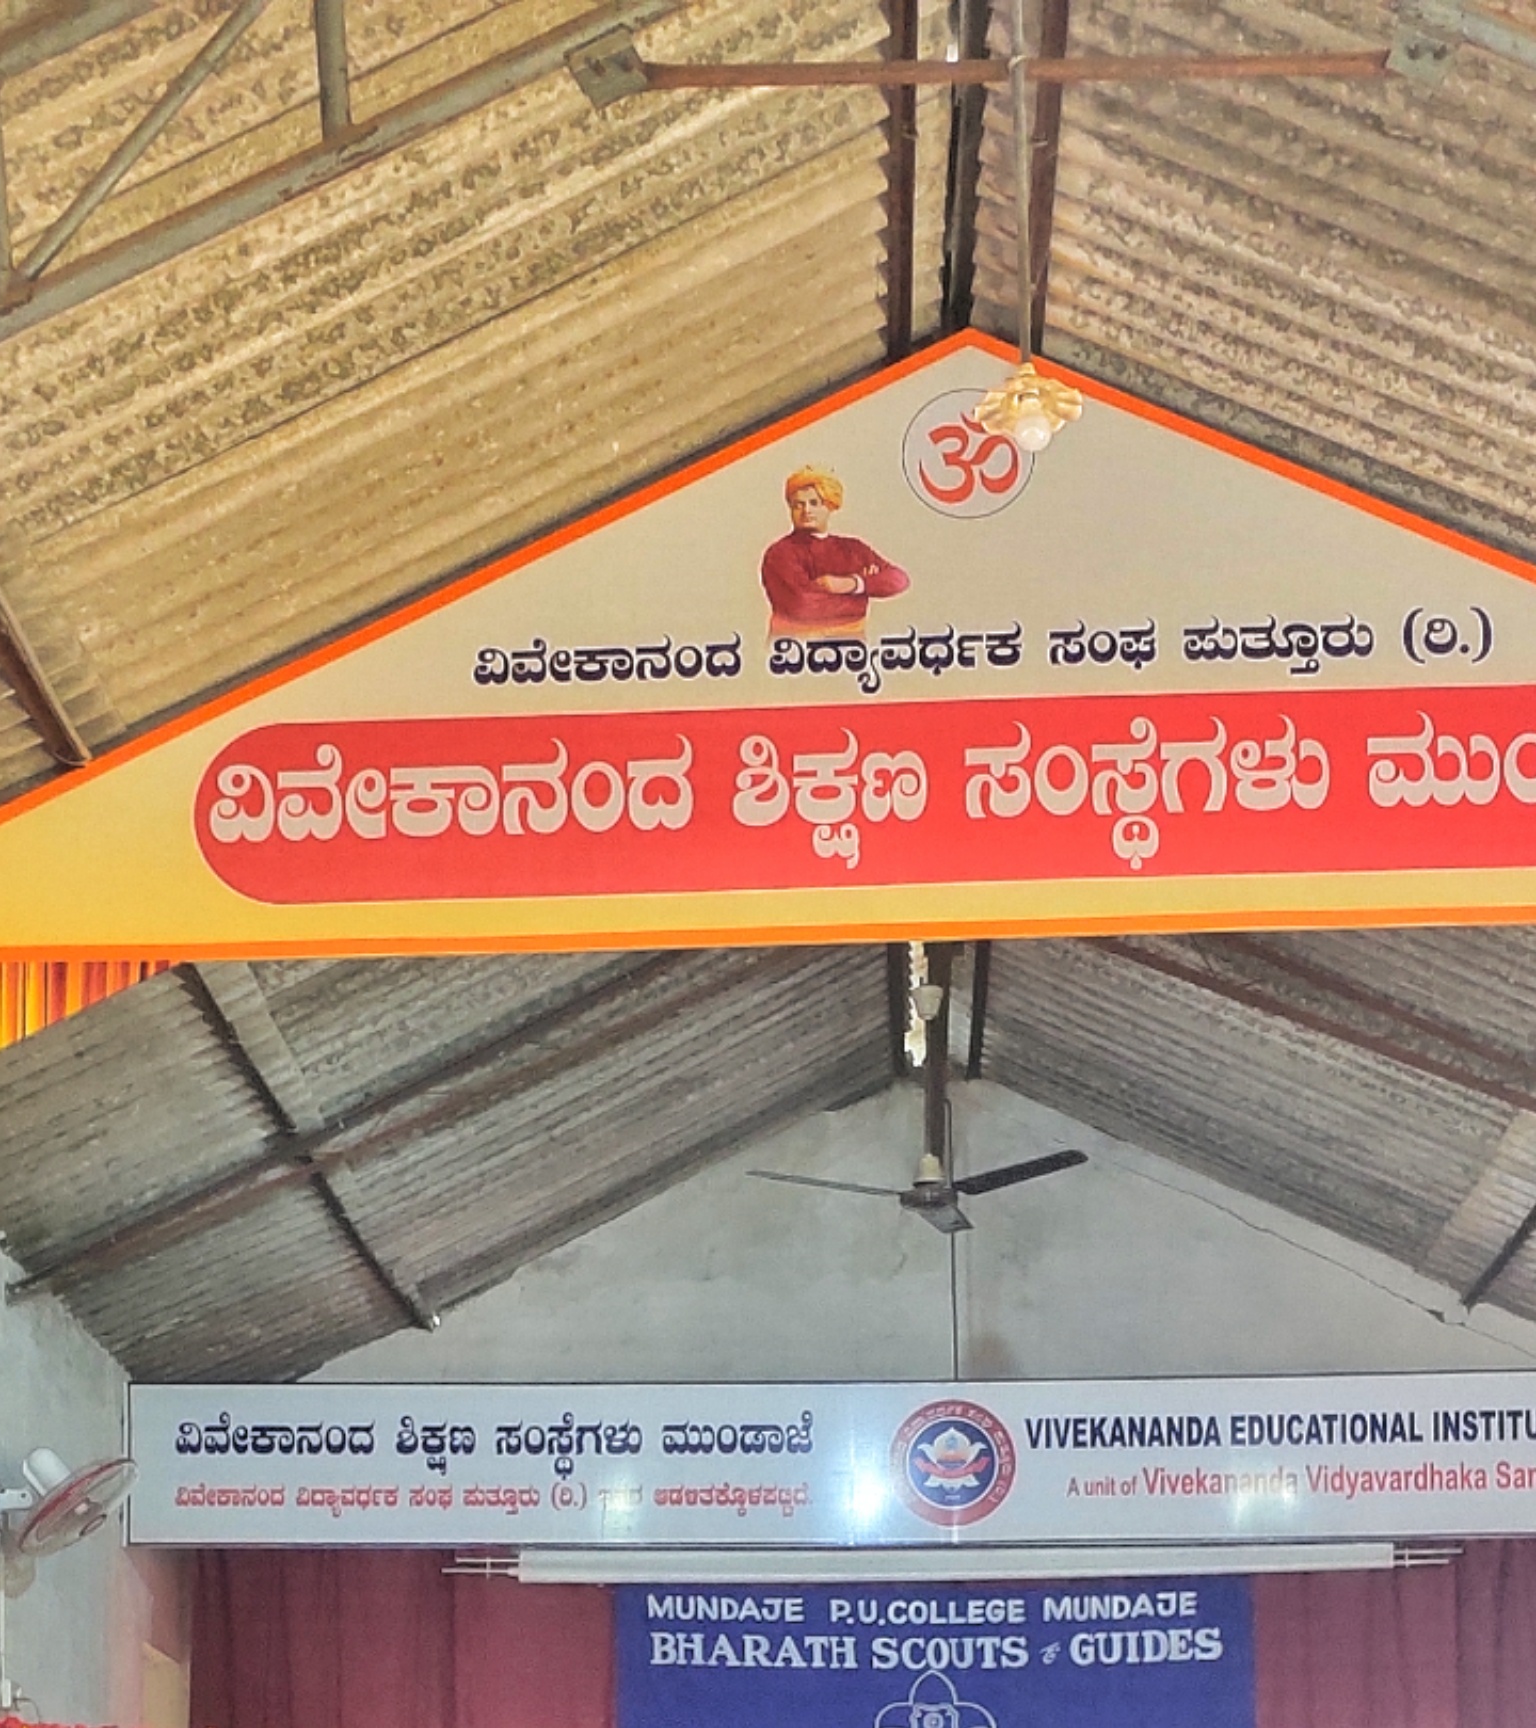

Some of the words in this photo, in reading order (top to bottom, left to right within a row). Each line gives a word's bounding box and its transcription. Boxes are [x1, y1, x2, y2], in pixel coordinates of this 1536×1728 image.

[474, 634, 741, 684] ವಿವೇಕಾನಂದ
[770, 621, 1023, 693] ವಿದ್ಯಾವರ್ಧಕ
[1050, 620, 1155, 669] ಸಂಘ
[1184, 615, 1373, 674] ಪುತ್ತೂರು
[209, 733, 694, 843] ವಿವೇಕಾನಂದ
[733, 730, 927, 869] ಶಿಕ್ಷಣ
[965, 715, 1331, 871] ಸಂಸ್ಥೆಗಳು
[176, 1412, 374, 1454] ವಿವೇಕಾನಂದ
[396, 1416, 475, 1475] ಶಿಕ್ಷಣ
[496, 1412, 642, 1480] ಸಂಸ್ಥೆಗಳು
[662, 1411, 812, 1454] ಮುಂಡಾಜೆ
[1026, 1416, 1220, 1448] VIVEKANANDA
[1231, 1412, 1423, 1445] EDUCATIONAL
[1067, 1477, 1079, 1497] A
[1084, 1476, 1116, 1496] unit
[1120, 1476, 1137, 1496] of
[1142, 1467, 1297, 1495] Vivekananda
[1306, 1461, 1487, 1499] Vidyavardhaka
[648, 1594, 804, 1621] MUNDAJE
[1044, 1592, 1197, 1621] MUNDAJE
[651, 1632, 857, 1668] BHARATH
[872, 1636, 1028, 1670] SCOUTS
[1070, 1628, 1222, 1665] GUIDES
